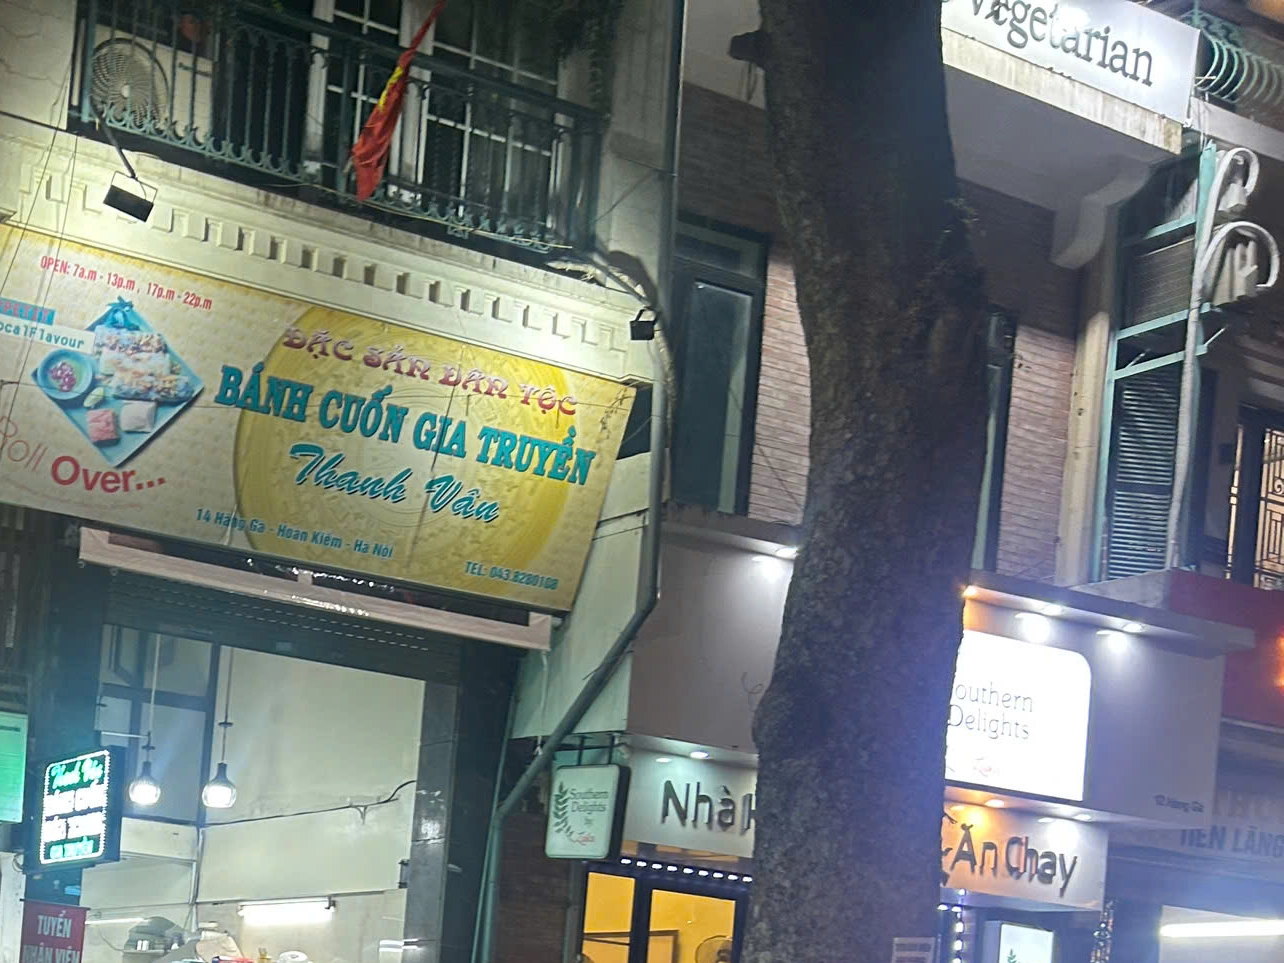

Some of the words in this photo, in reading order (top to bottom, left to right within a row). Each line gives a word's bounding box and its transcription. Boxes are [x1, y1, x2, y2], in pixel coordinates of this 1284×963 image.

[40, 255, 70, 275] OPEN:
[518, 383, 578, 415] TỘC
[214, 361, 314, 423] BÁNH
[317, 384, 410, 444] CUỐN
[413, 412, 467, 459] GIA
[476, 424, 598, 486] TRUYỀN
[289, 441, 414, 504] Thanh
[424, 473, 501, 524] Vân
[195, 509, 210, 523] 14
[953, 681, 1034, 712] outhern
[948, 704, 1031, 741] Delights
[661, 779, 736, 832] Nhà
[1005, 836, 1078, 898] Chay
